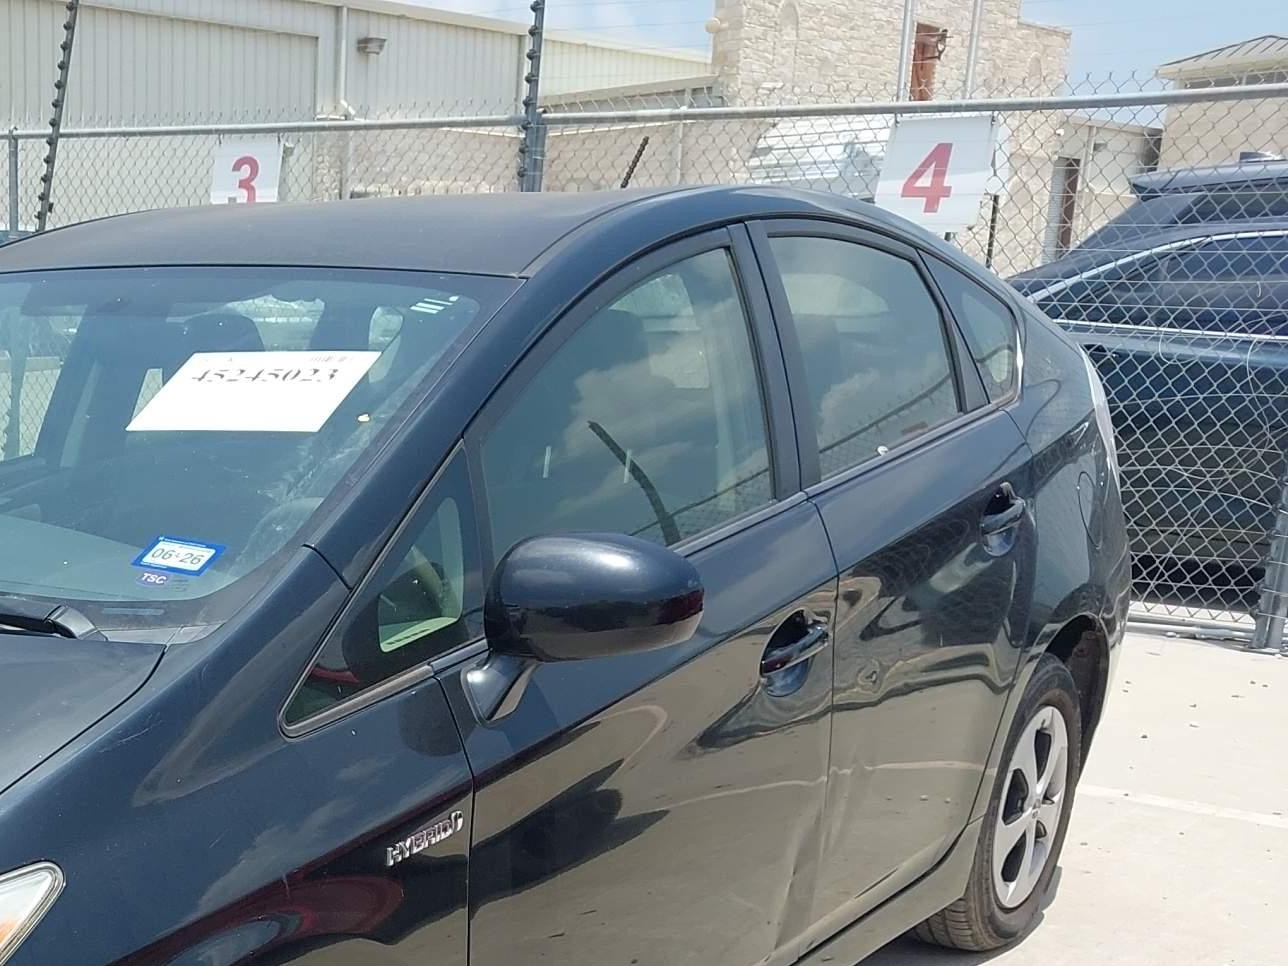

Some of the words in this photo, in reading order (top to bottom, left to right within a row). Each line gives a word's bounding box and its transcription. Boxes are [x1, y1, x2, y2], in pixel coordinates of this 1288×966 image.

[231, 155, 259, 204] 3
[900, 142, 954, 213] 4
[191, 368, 339, 383] 45245023
[141, 572, 167, 584] TSC
[386, 810, 464, 867] HYBRID
